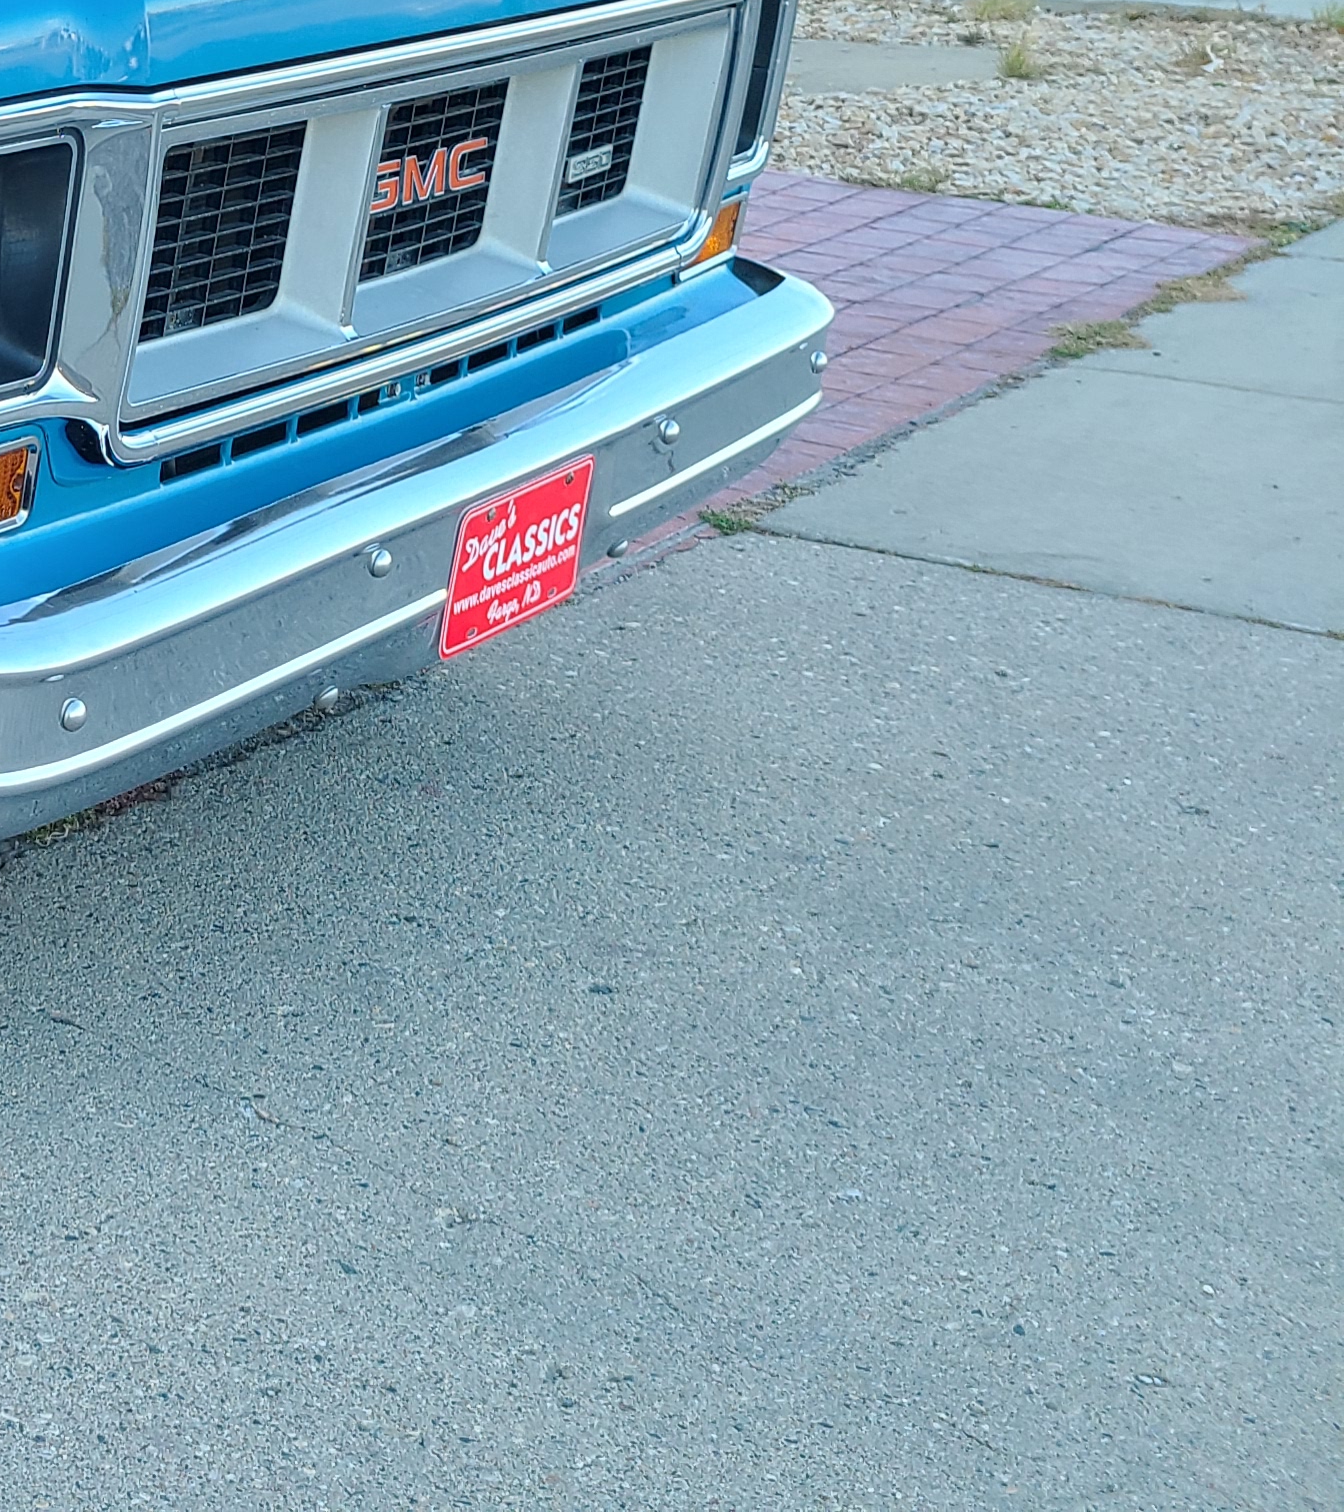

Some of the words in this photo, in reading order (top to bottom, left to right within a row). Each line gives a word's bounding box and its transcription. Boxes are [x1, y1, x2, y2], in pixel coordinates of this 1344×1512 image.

[370, 136, 489, 213] GMC
[461, 498, 518, 573] Dave's
[482, 502, 582, 582] CLASSICS
[453, 544, 576, 616] www.davesclassicauto.com
